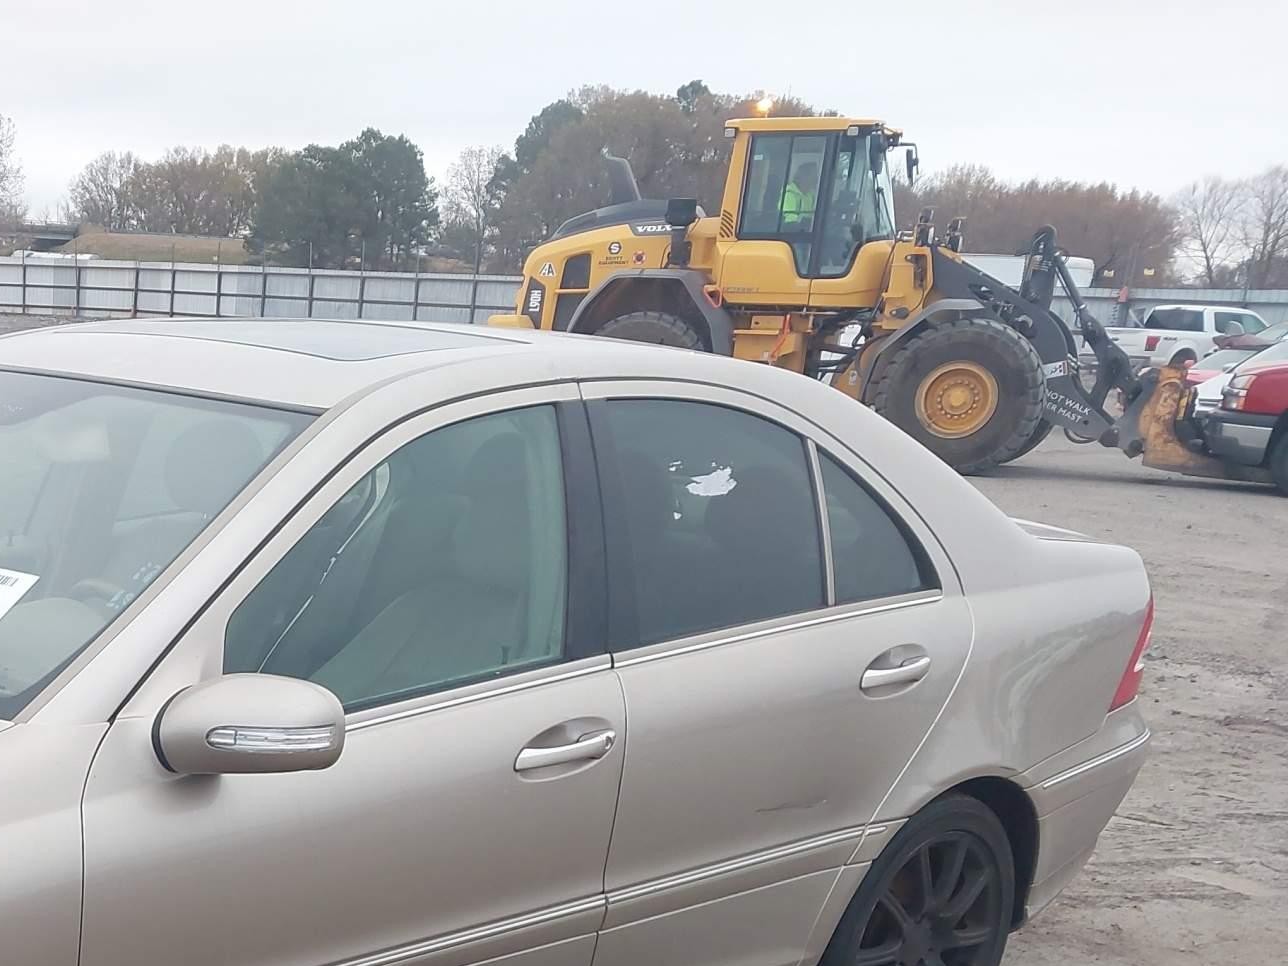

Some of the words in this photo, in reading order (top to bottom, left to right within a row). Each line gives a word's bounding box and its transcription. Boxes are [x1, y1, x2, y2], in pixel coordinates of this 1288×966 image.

[529, 289, 541, 312] L90H
[1057, 407, 1082, 423] MAST
[1064, 399, 1091, 416] WALK
